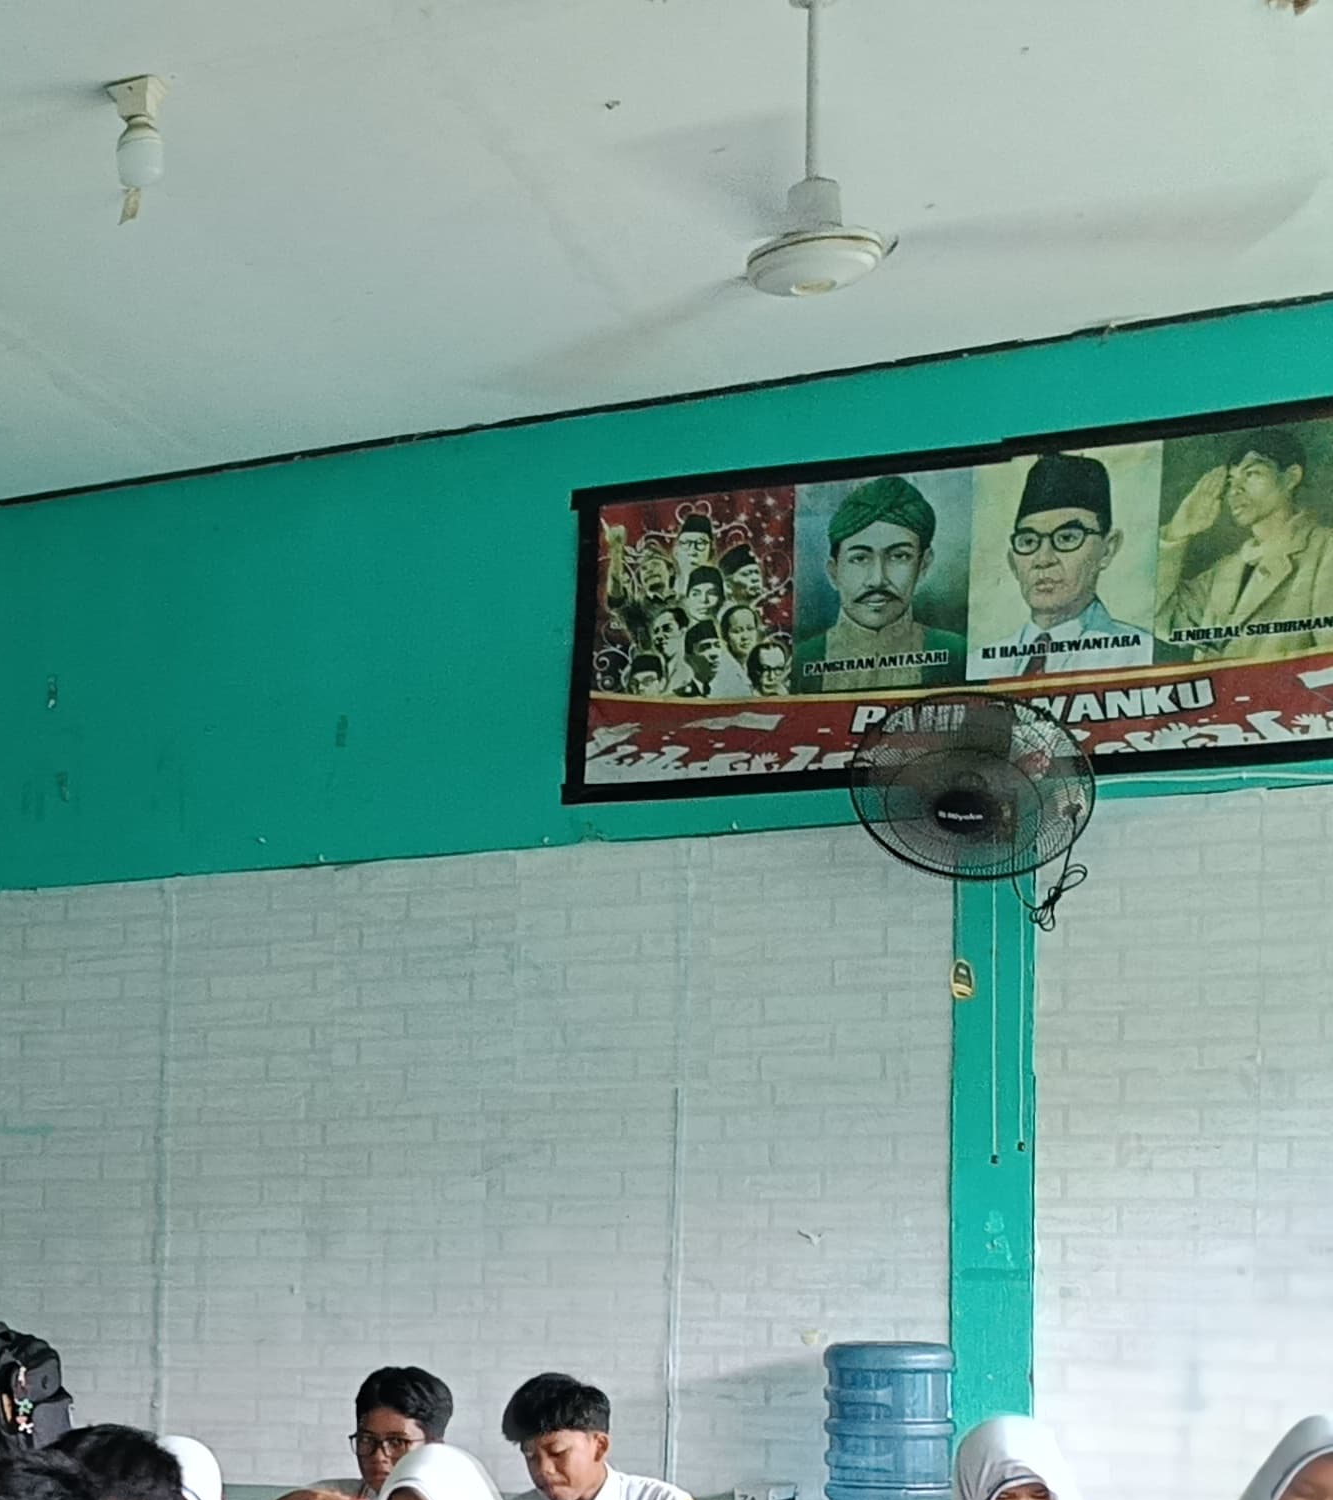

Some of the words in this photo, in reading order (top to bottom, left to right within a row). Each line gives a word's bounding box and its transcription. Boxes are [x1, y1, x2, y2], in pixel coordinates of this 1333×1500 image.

[982, 645, 997, 659] KI
[999, 641, 1048, 658] HAJAR
[1049, 634, 1141, 654] DEWANTARA
[1169, 626, 1241, 643] JENDERAL
[804, 655, 878, 677] PANGERAN
[879, 650, 949, 670] ANTASARI
